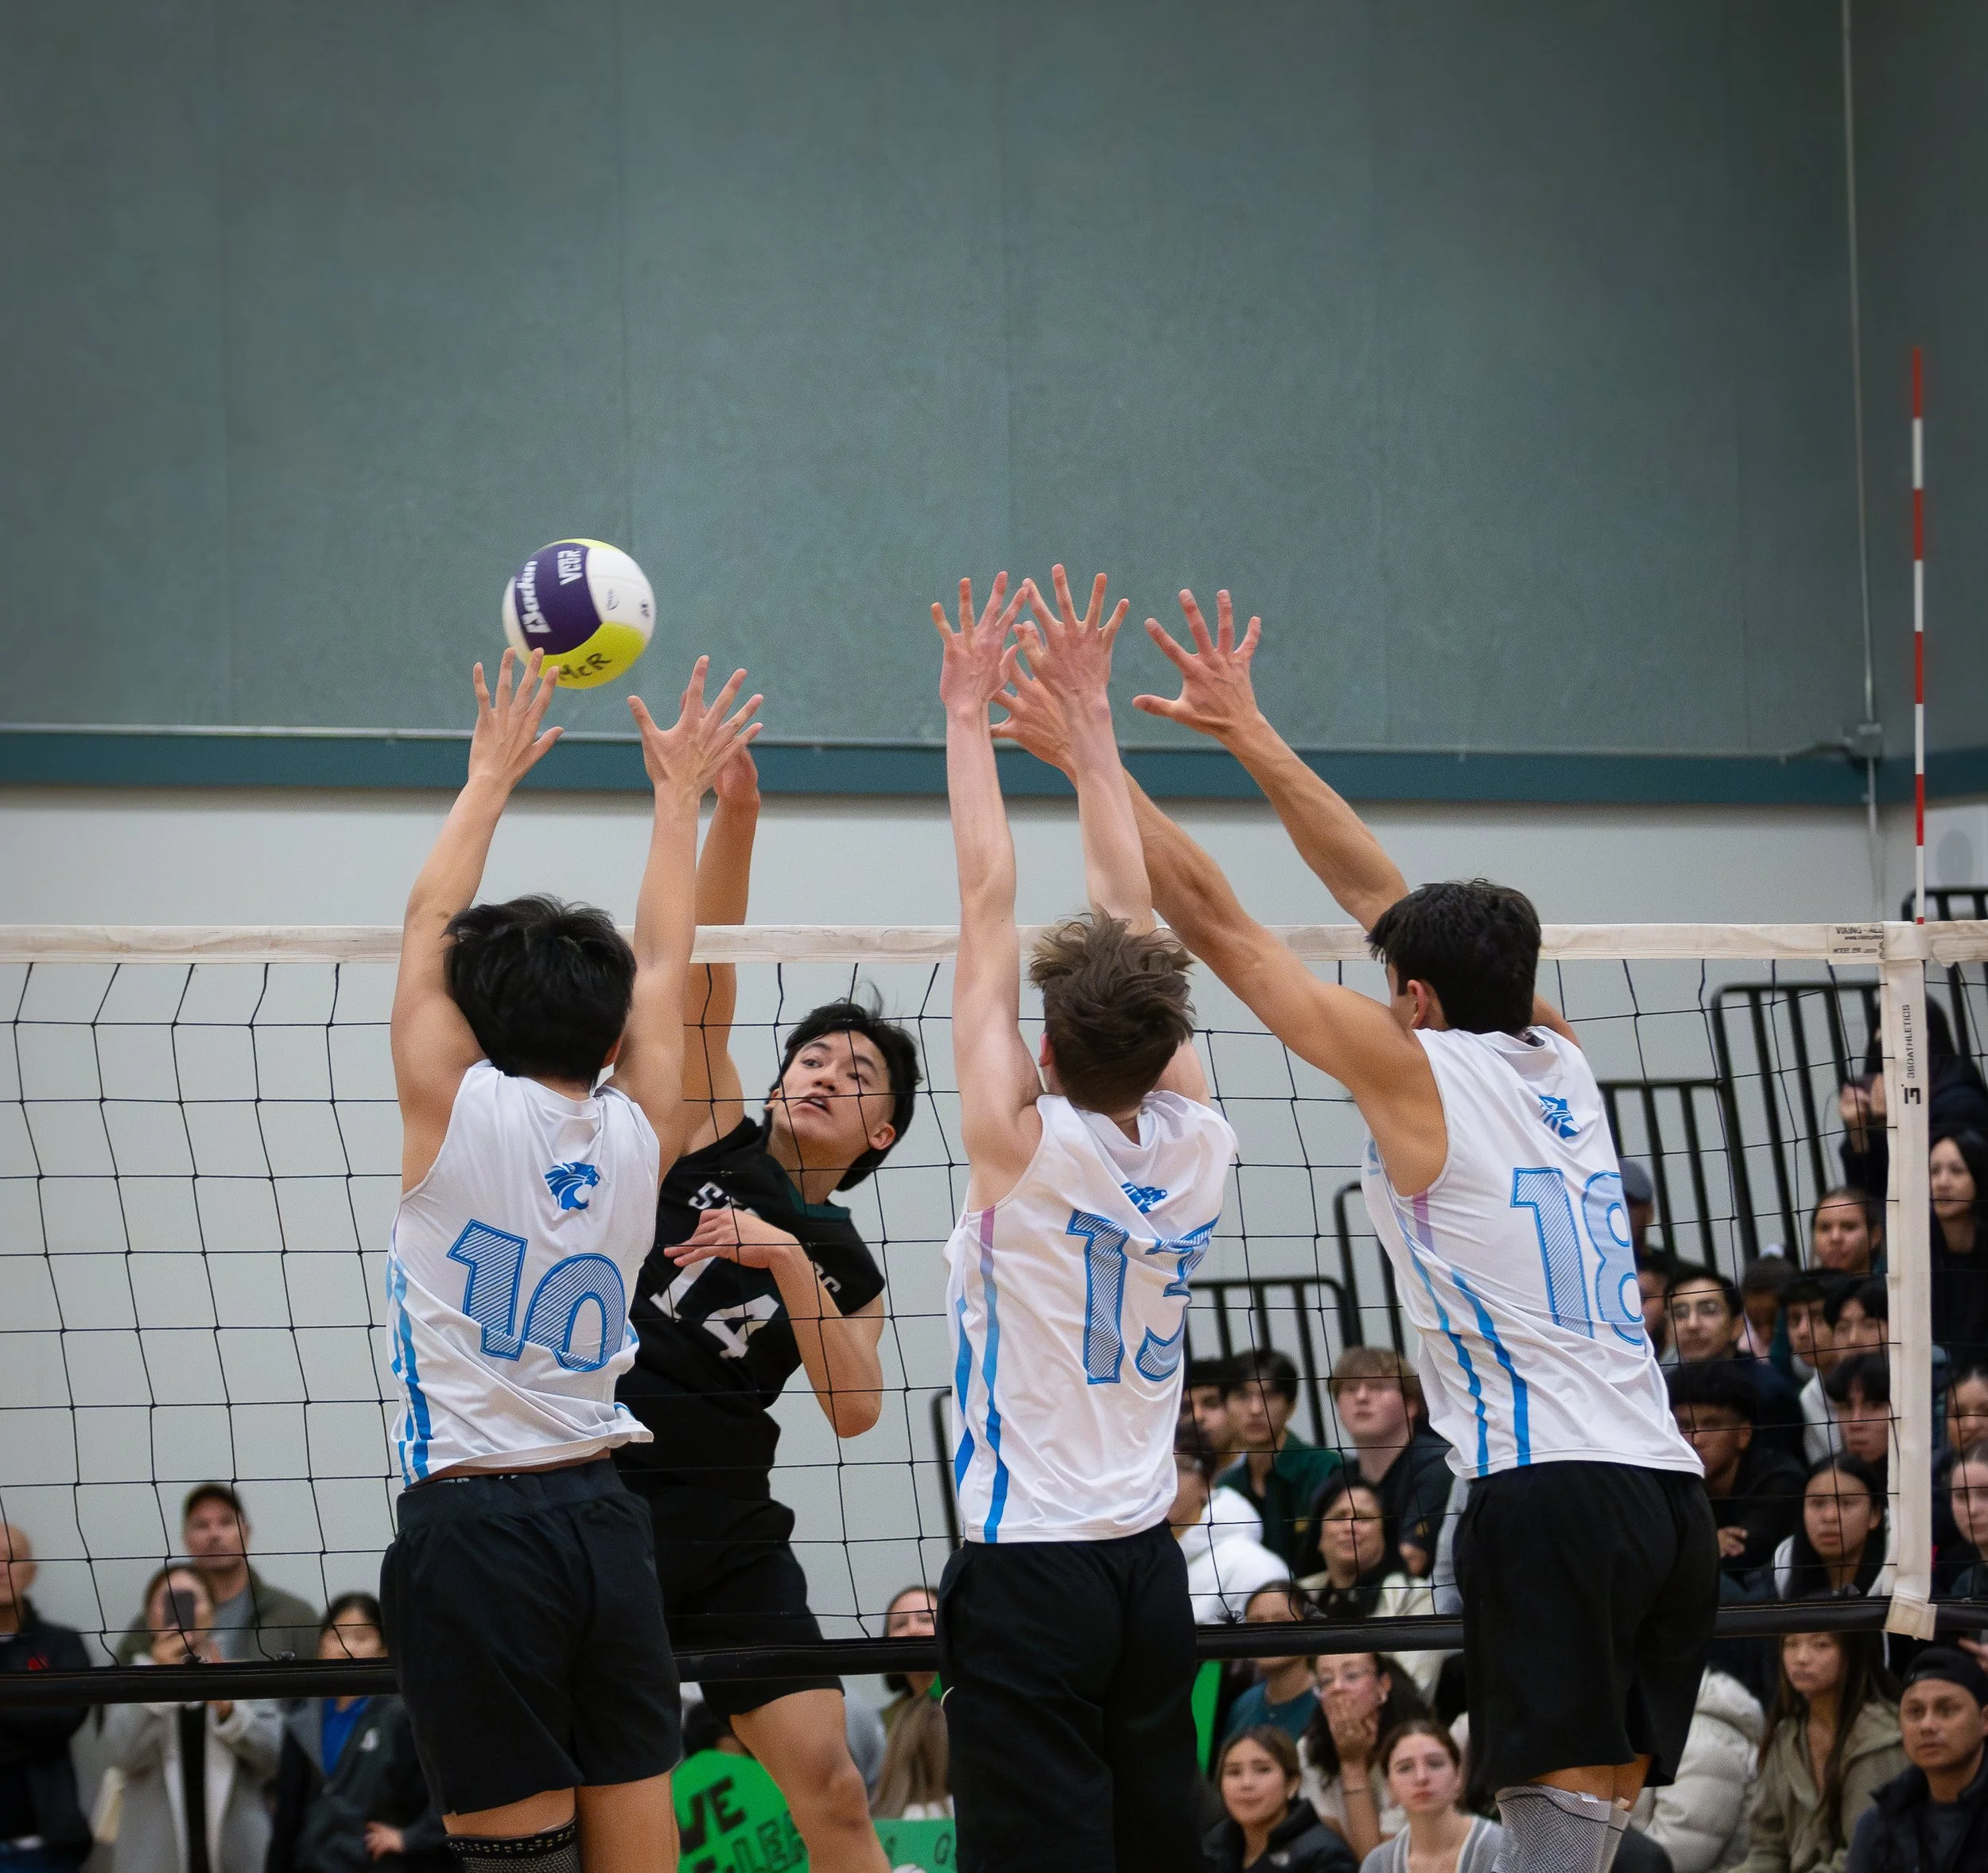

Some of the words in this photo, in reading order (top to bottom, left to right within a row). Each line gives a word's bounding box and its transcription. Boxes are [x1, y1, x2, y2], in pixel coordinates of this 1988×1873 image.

[517, 561, 552, 633] Baden
[446, 1218, 627, 1372] 10
[1066, 1209, 1221, 1385] 13
[1511, 1167, 1644, 1346] 18
